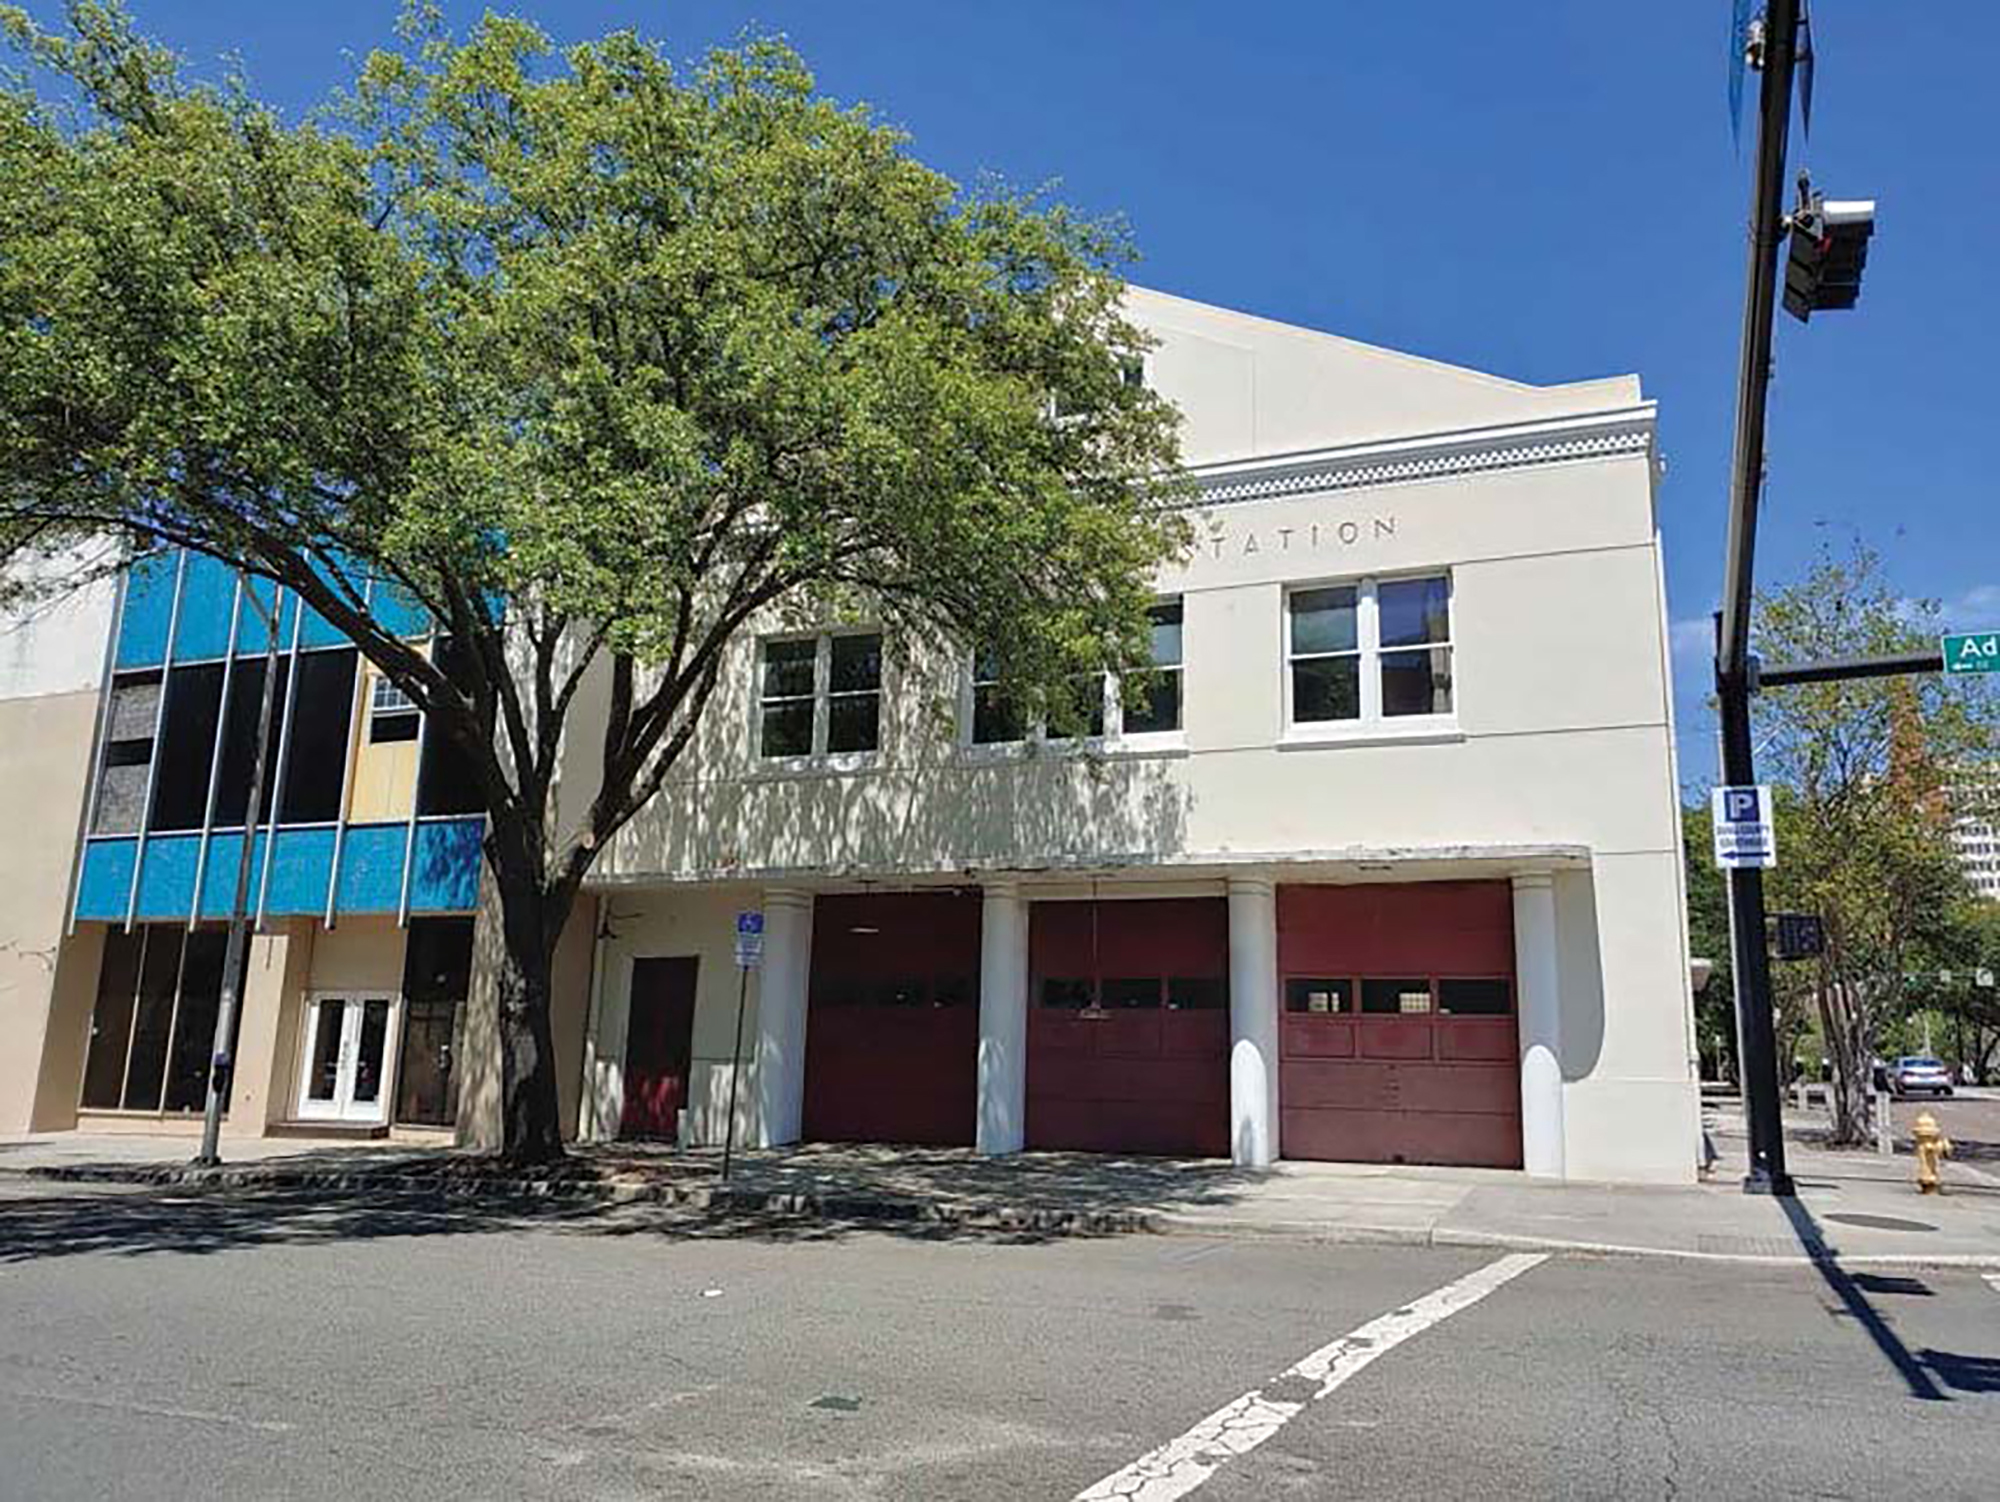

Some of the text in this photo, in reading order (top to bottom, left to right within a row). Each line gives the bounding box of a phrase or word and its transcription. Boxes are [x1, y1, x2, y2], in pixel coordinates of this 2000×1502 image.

[1186, 517, 1395, 558] TATION
[1960, 636, 1998, 657] Ad
[1730, 794, 1754, 818] P
